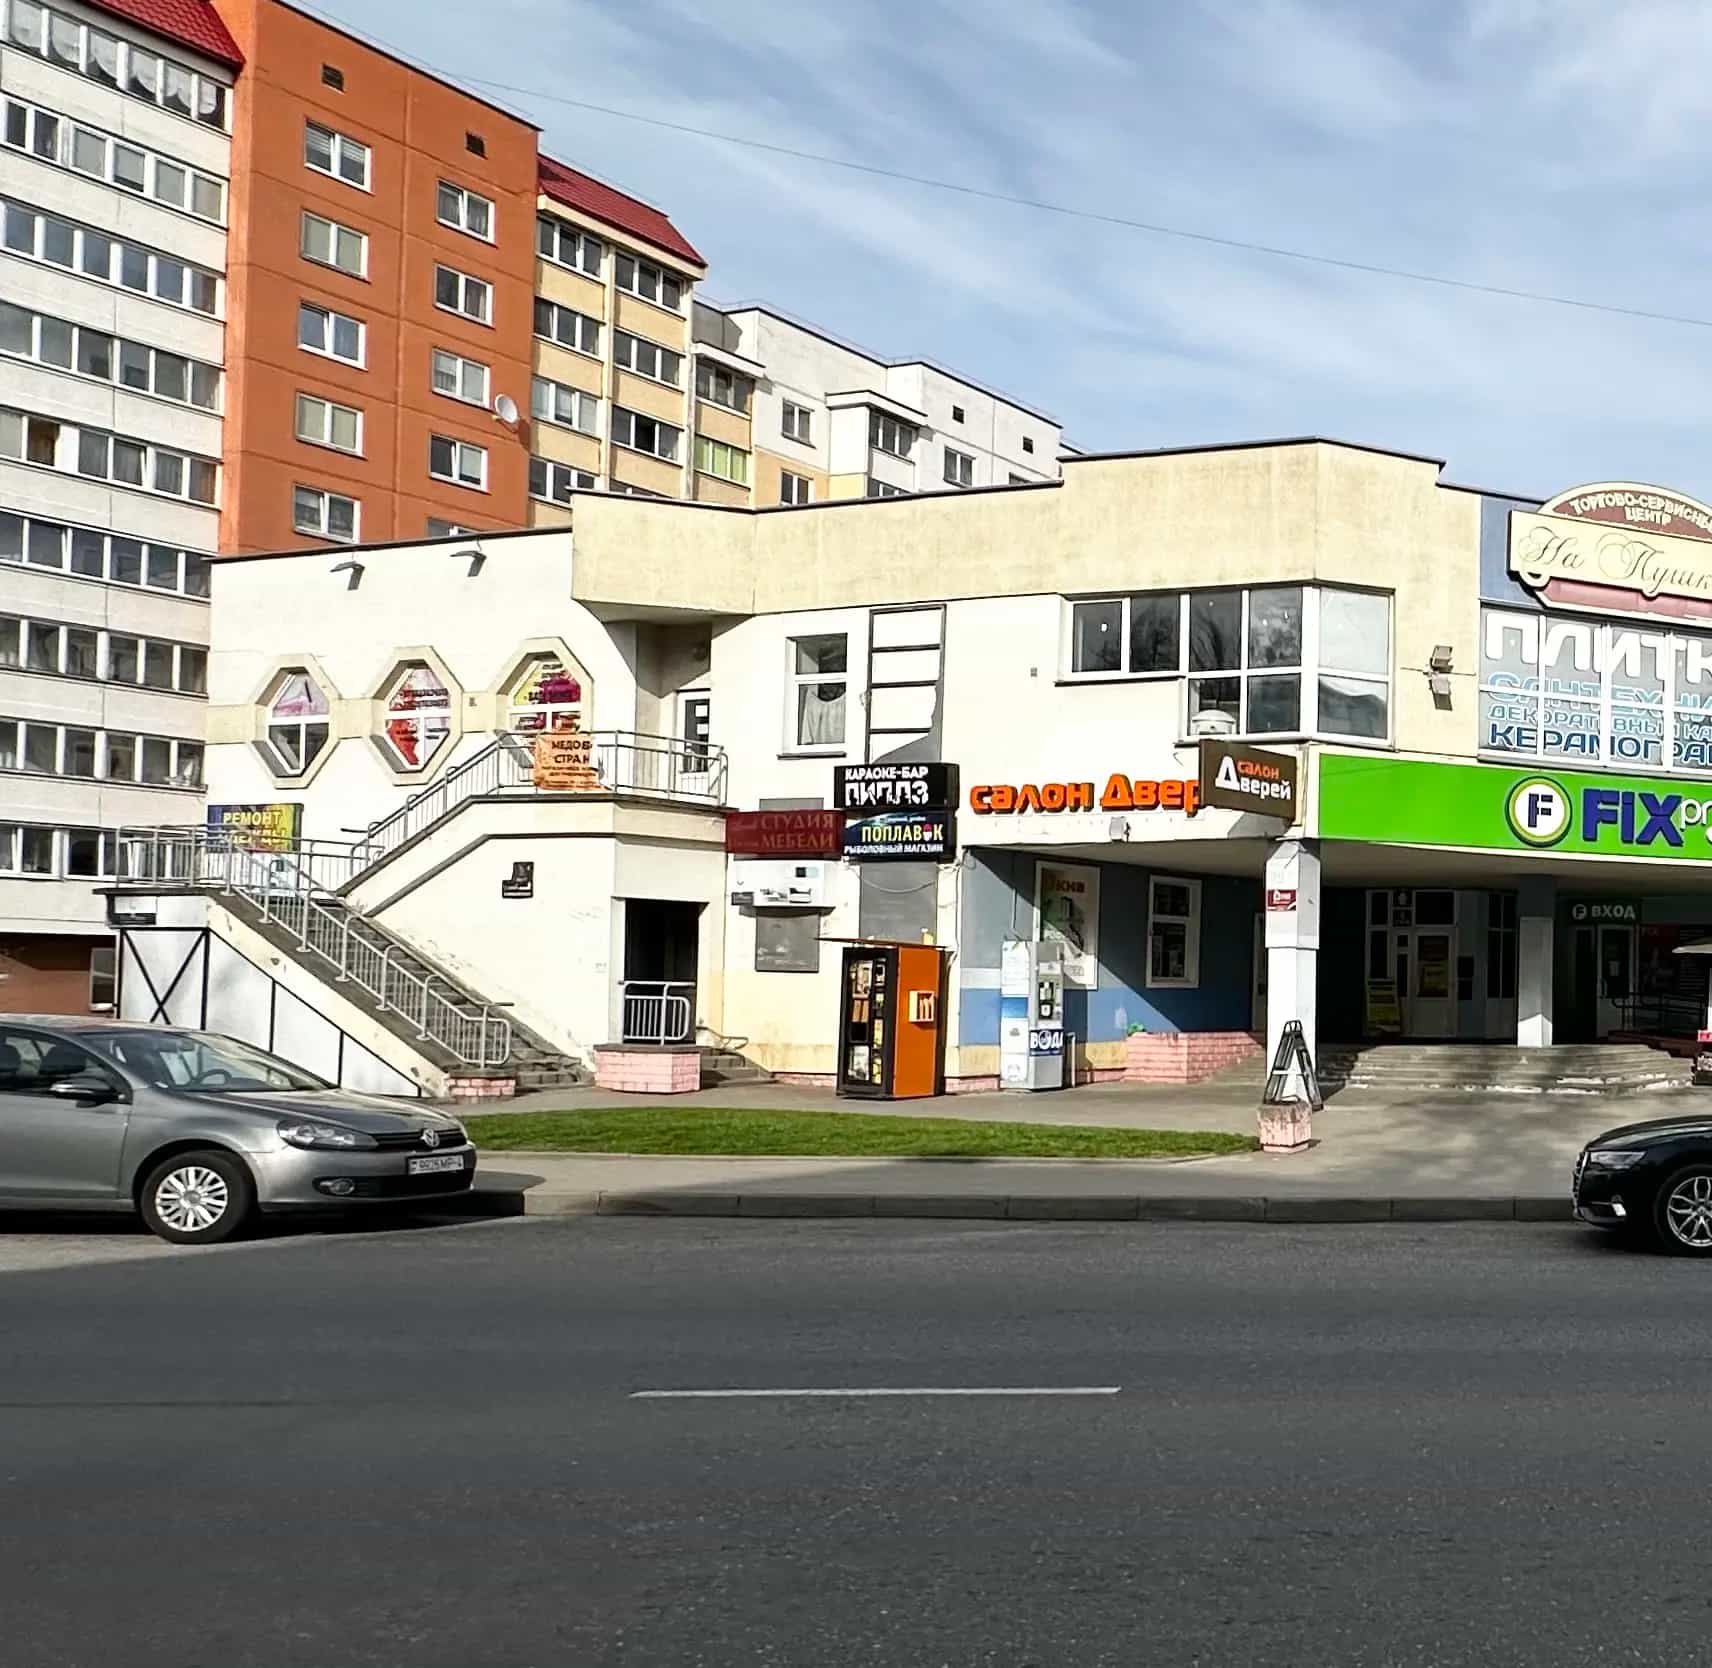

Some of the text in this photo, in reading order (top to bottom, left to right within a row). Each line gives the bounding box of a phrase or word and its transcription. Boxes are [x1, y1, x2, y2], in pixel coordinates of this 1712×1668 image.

[1625, 506, 1672, 526] ЦЕНТР
[1518, 526, 1584, 569] На
[1488, 704, 1680, 738] ДЕКОРАТВНЫ
[845, 766, 929, 780] КАРАОКЕ-БАР
[1215, 755, 1291, 800] Дверей
[1237, 760, 1279, 779] салон
[970, 773, 1199, 818] салон Двер
[223, 811, 282, 825] РЕМОНТ
[761, 814, 833, 830] СТУДИЯ
[760, 833, 833, 849] МЕБЕЛИ
[862, 823, 943, 842] ПОПЛАВОК
[904, 843, 943, 853] МАГАЗИН
[1591, 905, 1636, 919] ВХОД
